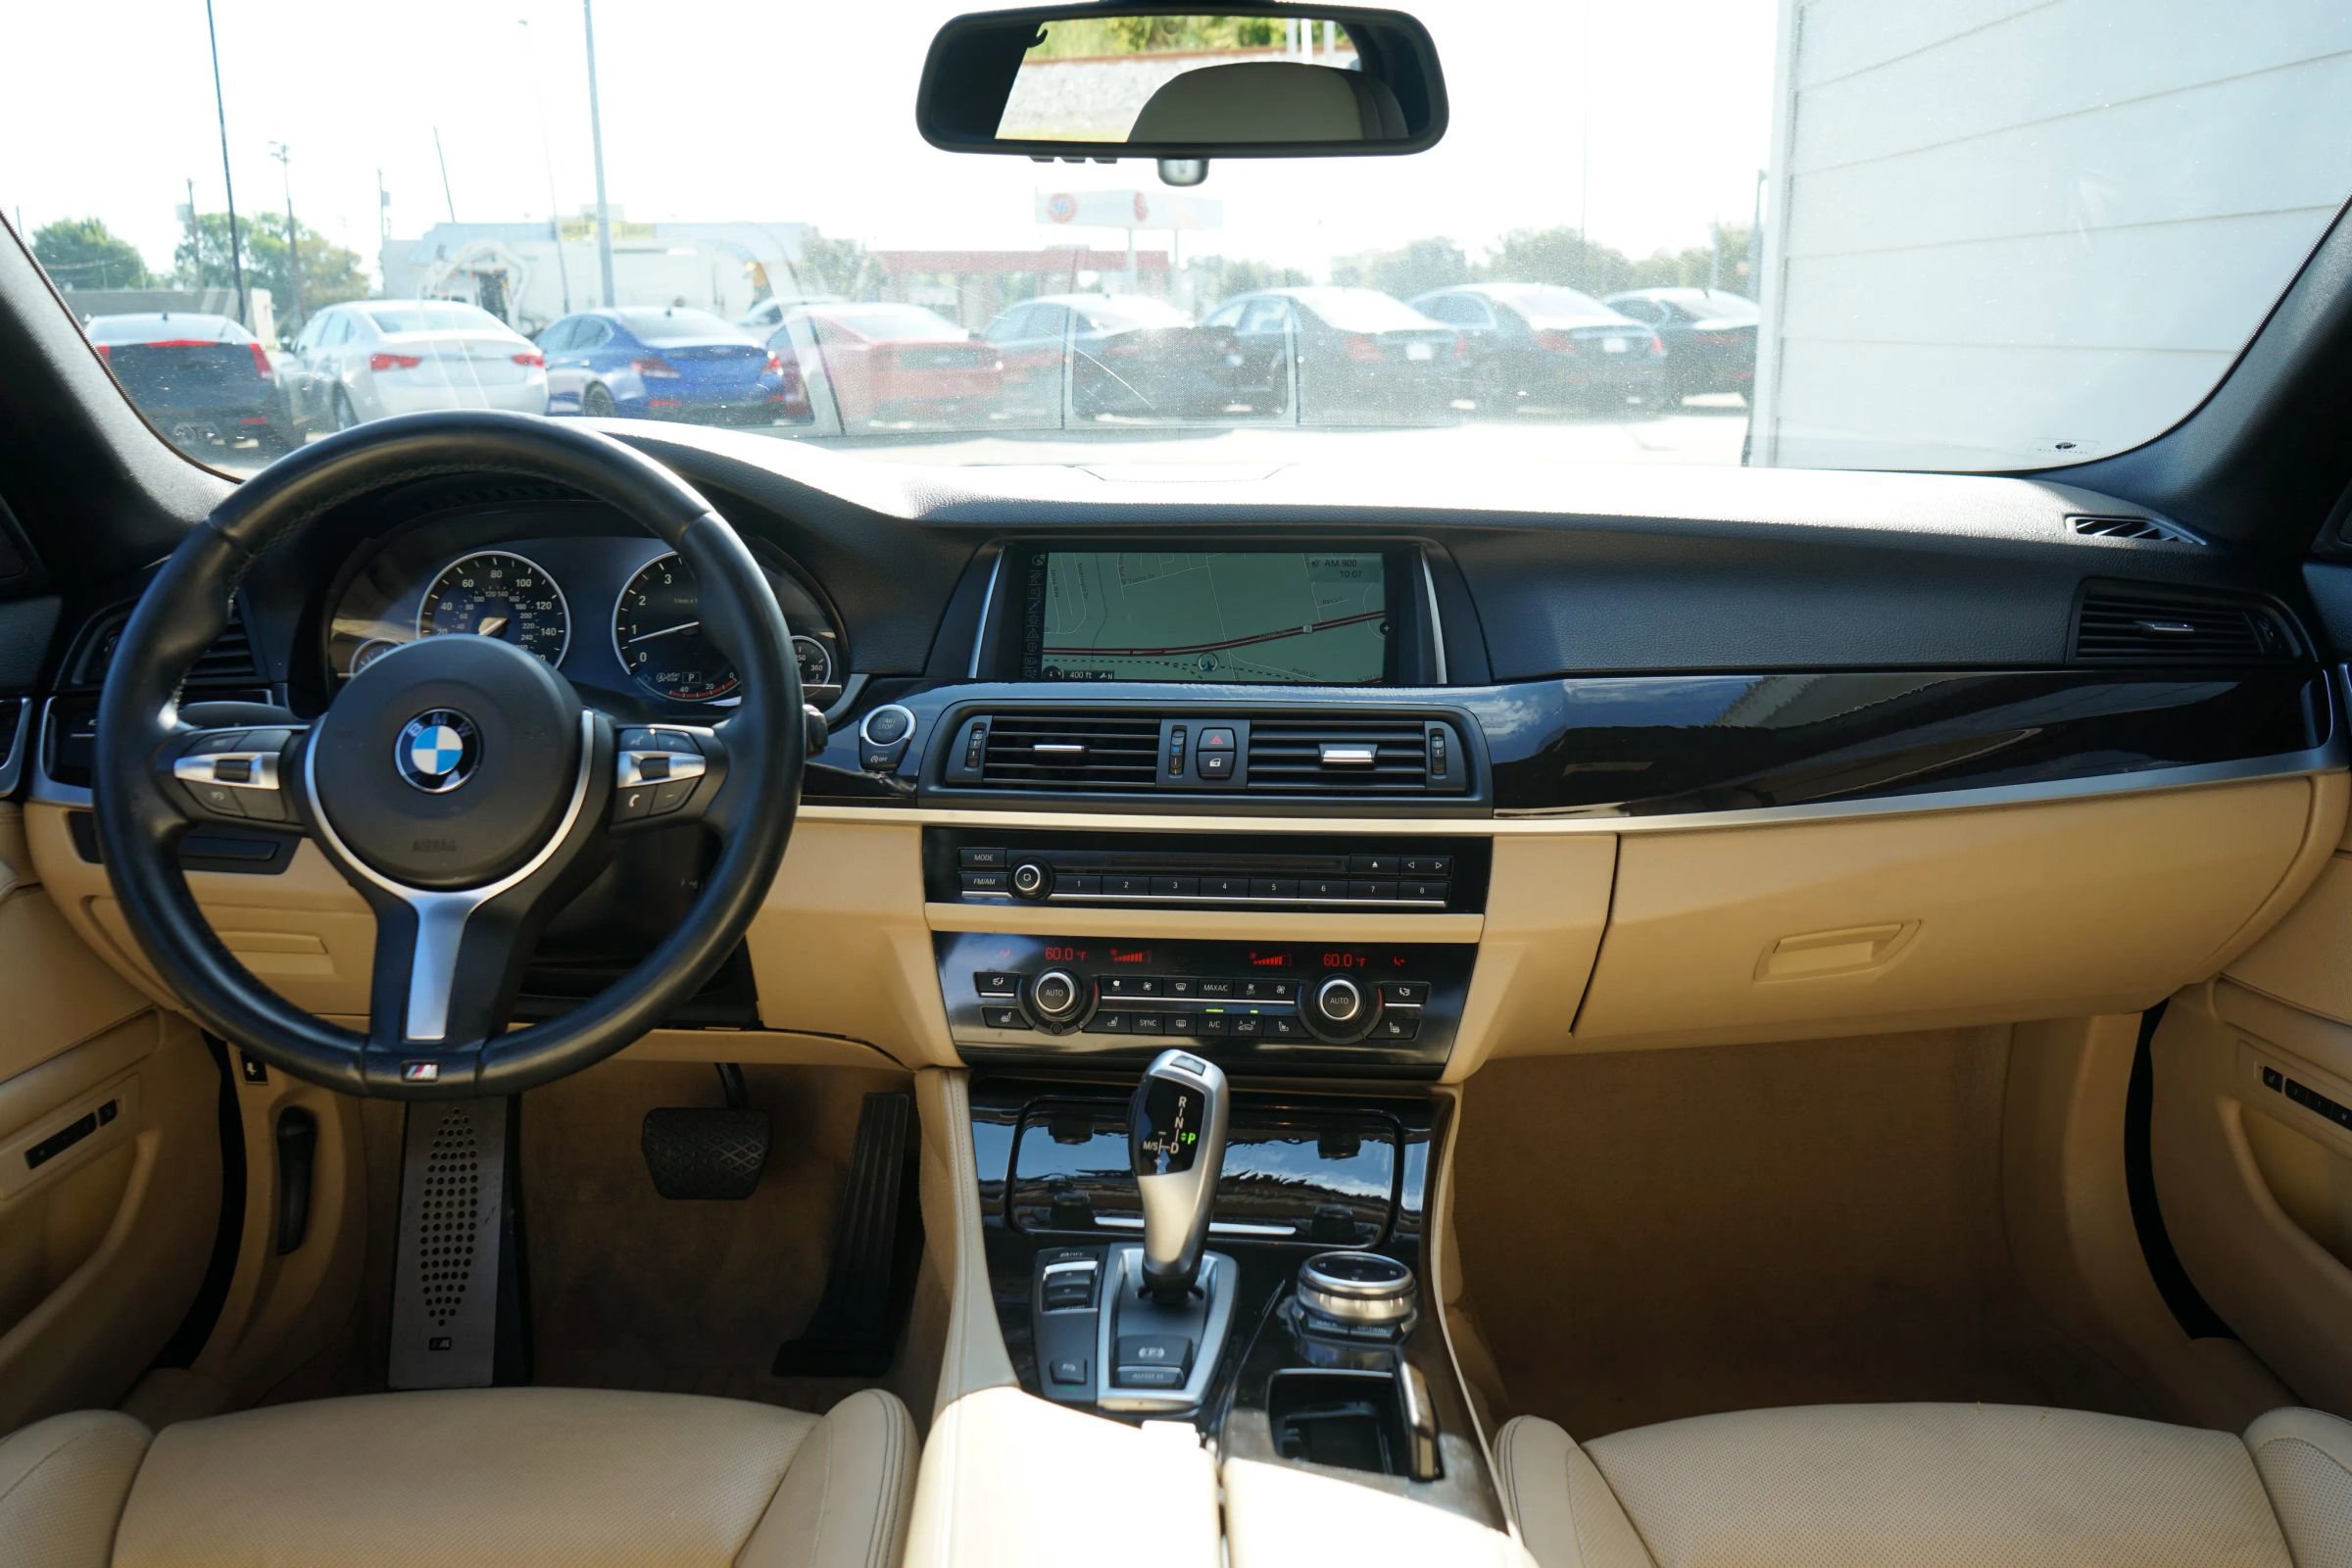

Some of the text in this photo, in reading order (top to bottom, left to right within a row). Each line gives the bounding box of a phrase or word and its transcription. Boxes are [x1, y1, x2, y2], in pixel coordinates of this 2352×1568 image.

[1342, 560, 1357, 568] 900
[490, 569, 503, 578] 80
[462, 579, 474, 588] 60
[515, 578, 532, 587] 100
[663, 573, 672, 585] 3
[536, 601, 552, 610] 120
[638, 595, 647, 606] 2
[441, 602, 453, 611] 40
[541, 627, 557, 636] 140
[631, 624, 637, 635] 1
[639, 652, 647, 662] 0
[688, 673, 695, 682] P
[407, 712, 472, 737] BMW
[1045, 947, 1074, 961] 60.0
[1323, 953, 1353, 967] 60.0
[1139, 1018, 1157, 1027] SYNC
[1178, 1097, 1187, 1107] R
[1174, 1117, 1184, 1129] N
[1187, 1133, 1196, 1145] P
[1143, 1140, 1179, 1154] M/S D
